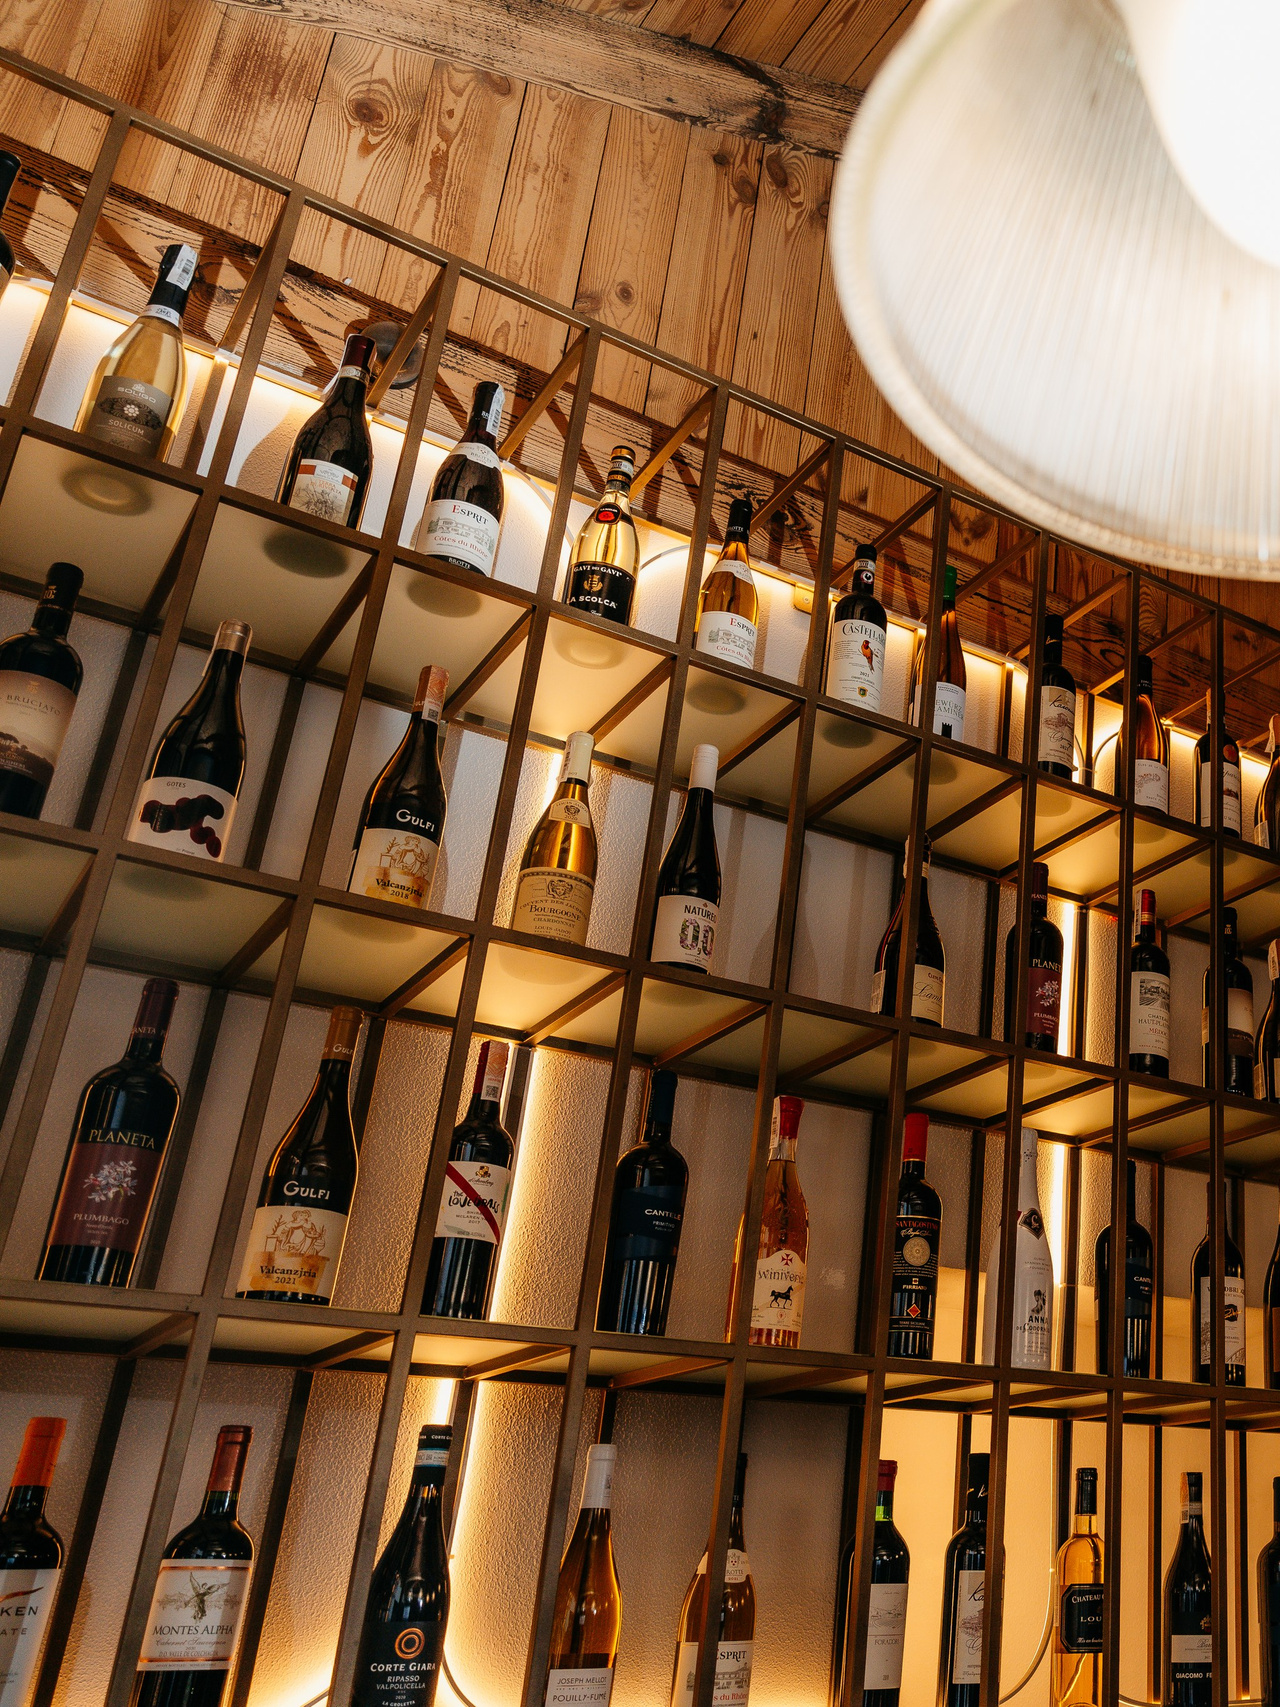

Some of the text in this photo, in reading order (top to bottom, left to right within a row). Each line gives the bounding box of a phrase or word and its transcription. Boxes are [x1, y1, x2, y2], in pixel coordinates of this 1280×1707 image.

[117, 386, 157, 404] SOLIGO
[108, 419, 145, 436] SOLICUM
[452, 504, 489, 526] ESPRIT
[434, 535, 457, 544] Côtes
[458, 539, 469, 547] du
[448, 557, 471, 570] BROTTE
[573, 565, 591, 574] GAVI
[7, 694, 61, 716] BRUCIATO
[396, 809, 435, 832] GULFI
[375, 878, 423, 898] Valcanzjria
[390, 890, 409, 900] 2018
[529, 904, 581, 921] BOURGOGNE
[533, 917, 576, 929] CHARDONNAY
[88, 1129, 155, 1149] PLANETA
[283, 1180, 331, 1200] GULFI
[73, 1212, 130, 1225] PLUMBAGO
[645, 1208, 681, 1220] CANTELE
[259, 1265, 317, 1279] Valcanzjria
[274, 1275, 297, 1285] 2021
[1028, 1315, 1049, 1324] ANNA
[1071, 1593, 1100, 1604] CHATEAU
[0, 1606, 39, 1616] KEN
[0, 1627, 28, 1635] ATE
[153, 1625, 234, 1636] MONTES ALPHA
[155, 1639, 188, 1647] Cabernet
[370, 1662, 436, 1672] CORTE GIARA
[376, 1682, 426, 1690] VALPOLICELLA
[584, 1676, 607, 1684] MELLOT
[552, 1691, 607, 1702] POUILLY-FUMÉ
[719, 1692, 730, 1701] du
